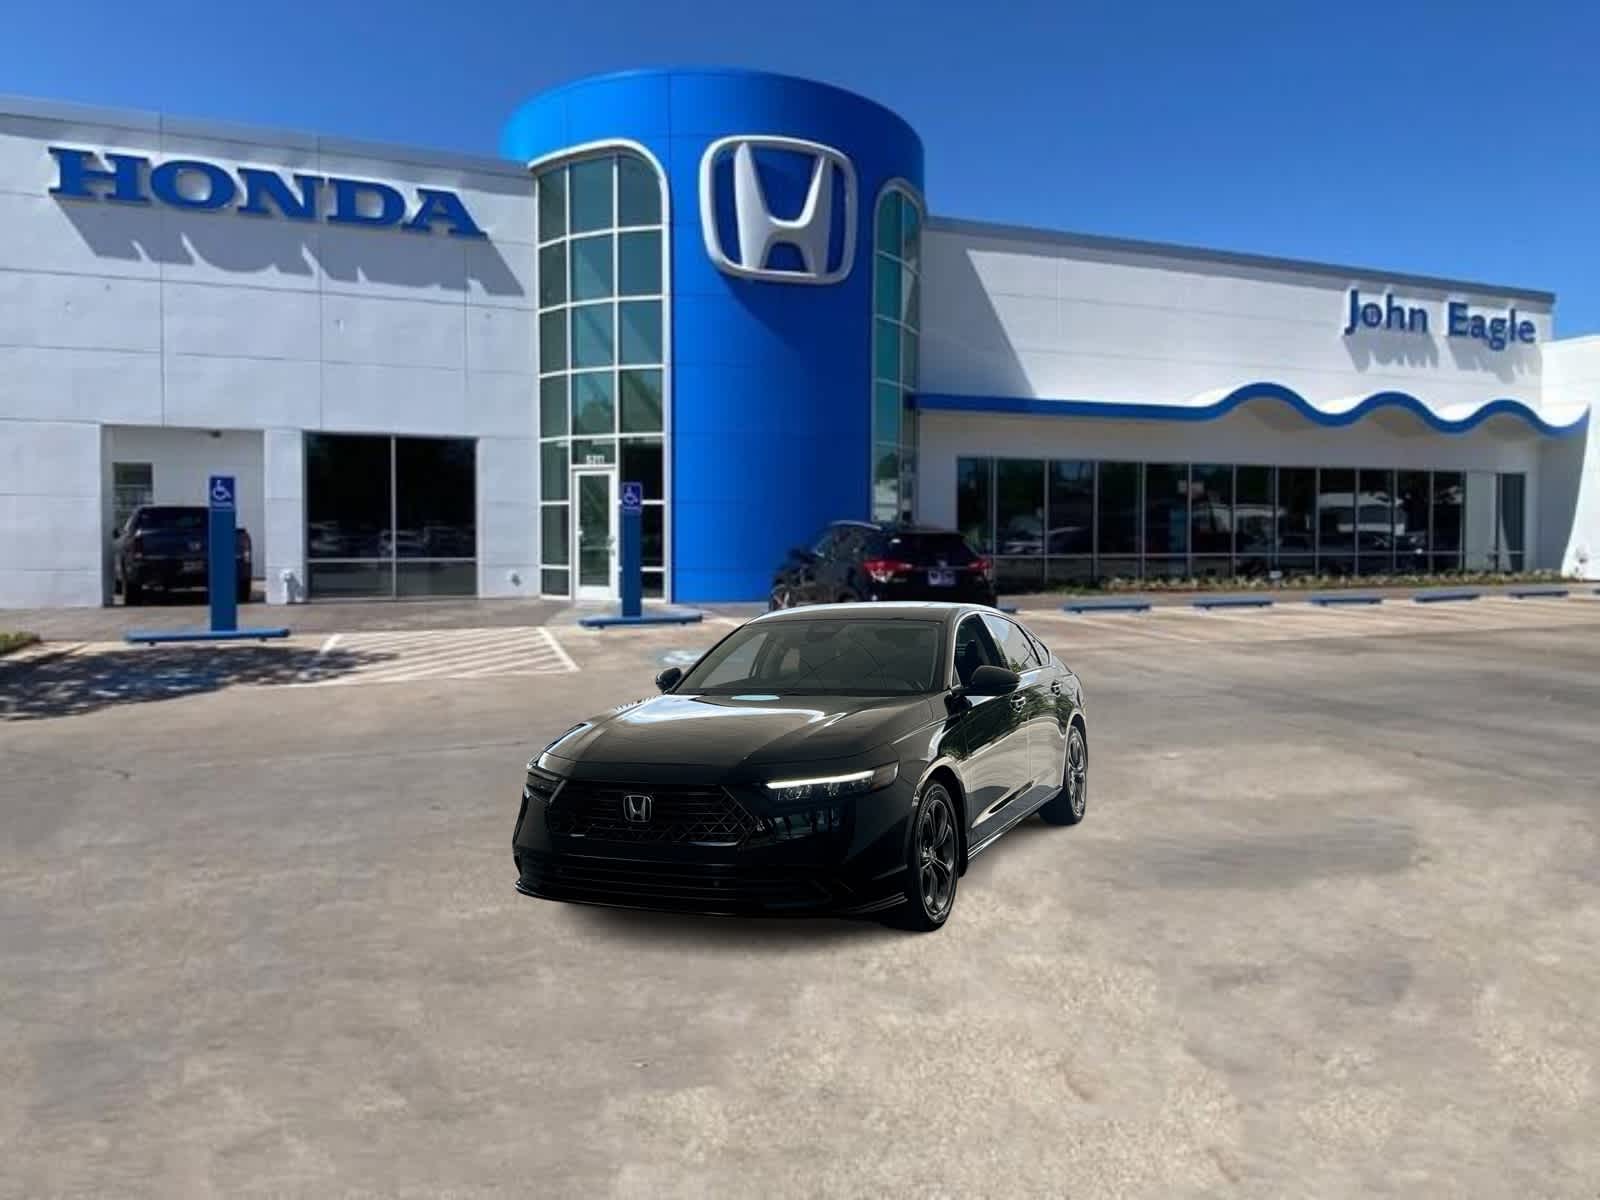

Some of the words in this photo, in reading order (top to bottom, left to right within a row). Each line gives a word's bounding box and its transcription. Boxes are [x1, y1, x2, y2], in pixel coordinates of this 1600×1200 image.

[48, 145, 488, 239] HONDA
[1345, 289, 1429, 336] John
[1448, 302, 1537, 351] Eagle
